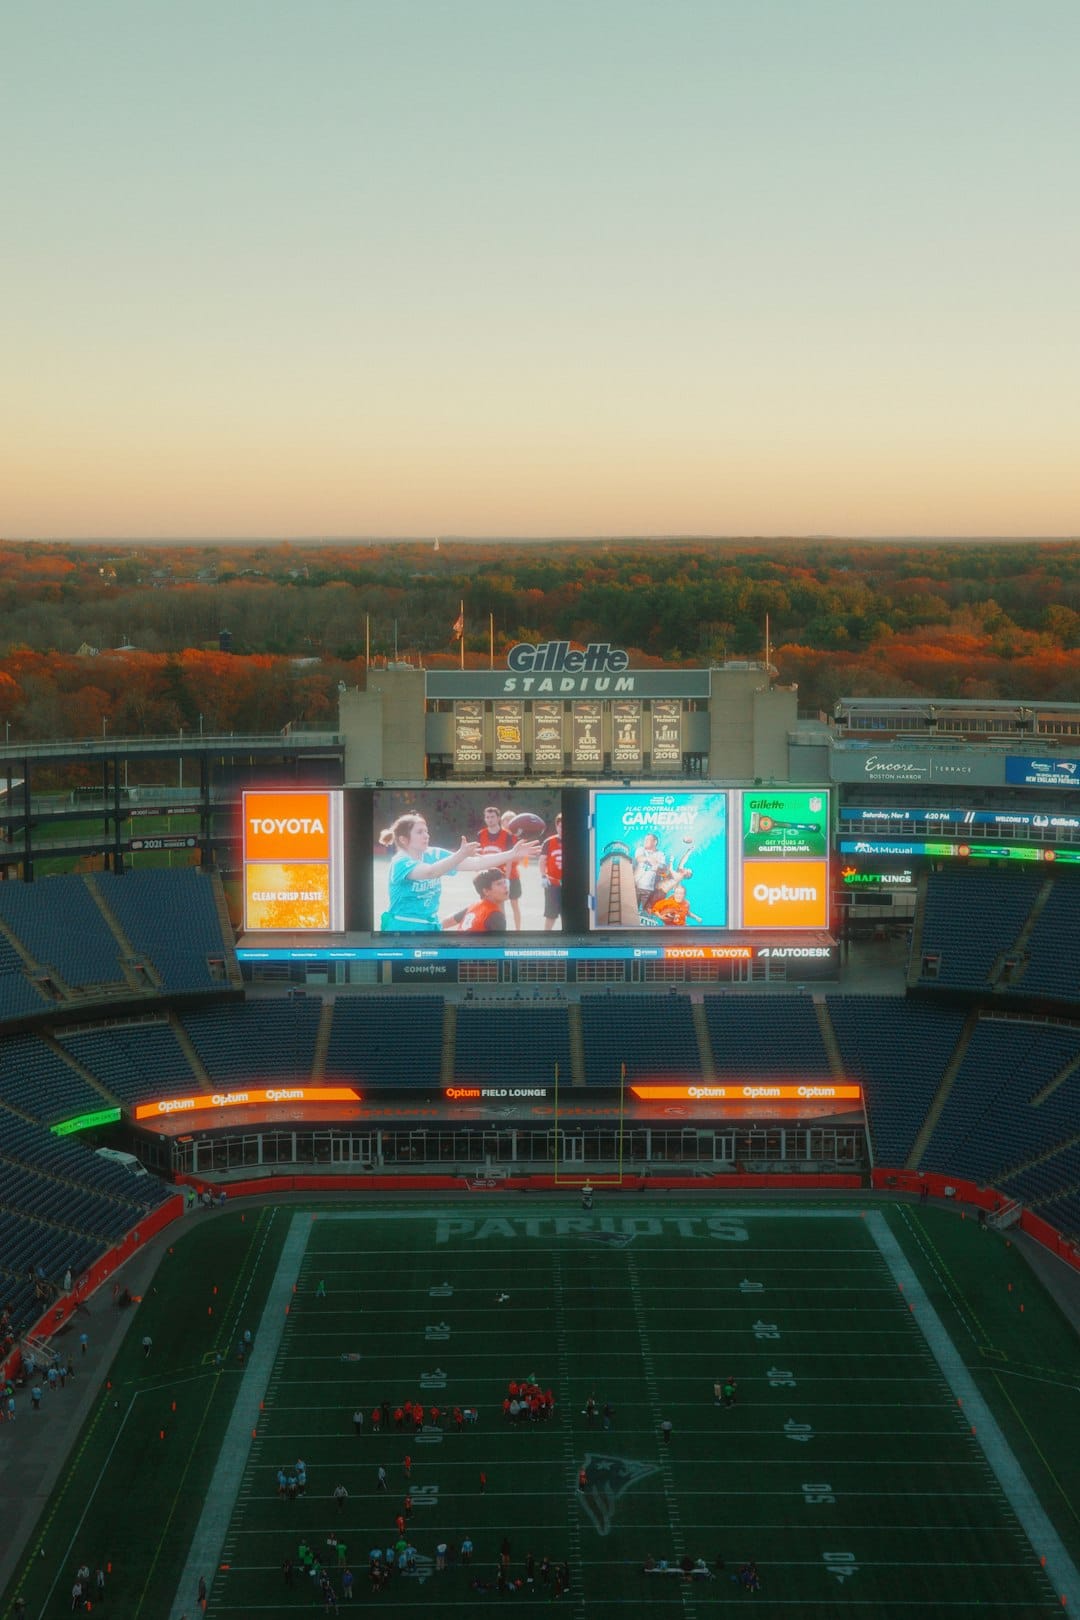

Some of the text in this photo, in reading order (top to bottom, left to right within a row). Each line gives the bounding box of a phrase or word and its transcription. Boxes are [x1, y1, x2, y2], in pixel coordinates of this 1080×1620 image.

[508, 640, 629, 673] Gillette
[504, 677, 635, 692] STADIUM
[458, 753, 481, 761] 2001
[865, 755, 926, 771] Encore
[750, 800, 784, 809] Gillette
[622, 812, 697, 825] GAMEDAY
[250, 819, 324, 834] TOYOTA
[252, 892, 323, 901] CLEAN CRISP TASTE
[753, 884, 816, 904] Optum
[666, 949, 704, 957] TOYOTA
[711, 949, 750, 957] TOYOTA
[771, 948, 830, 957] AUTODESK
[446, 1088, 547, 1099] Optum FIELD LOUNGE
[688, 1087, 835, 1098] Optum Optum Optum
[158, 1089, 303, 1112] Optum Optum Optum
[436, 1217, 749, 1244] PATRIOTS
